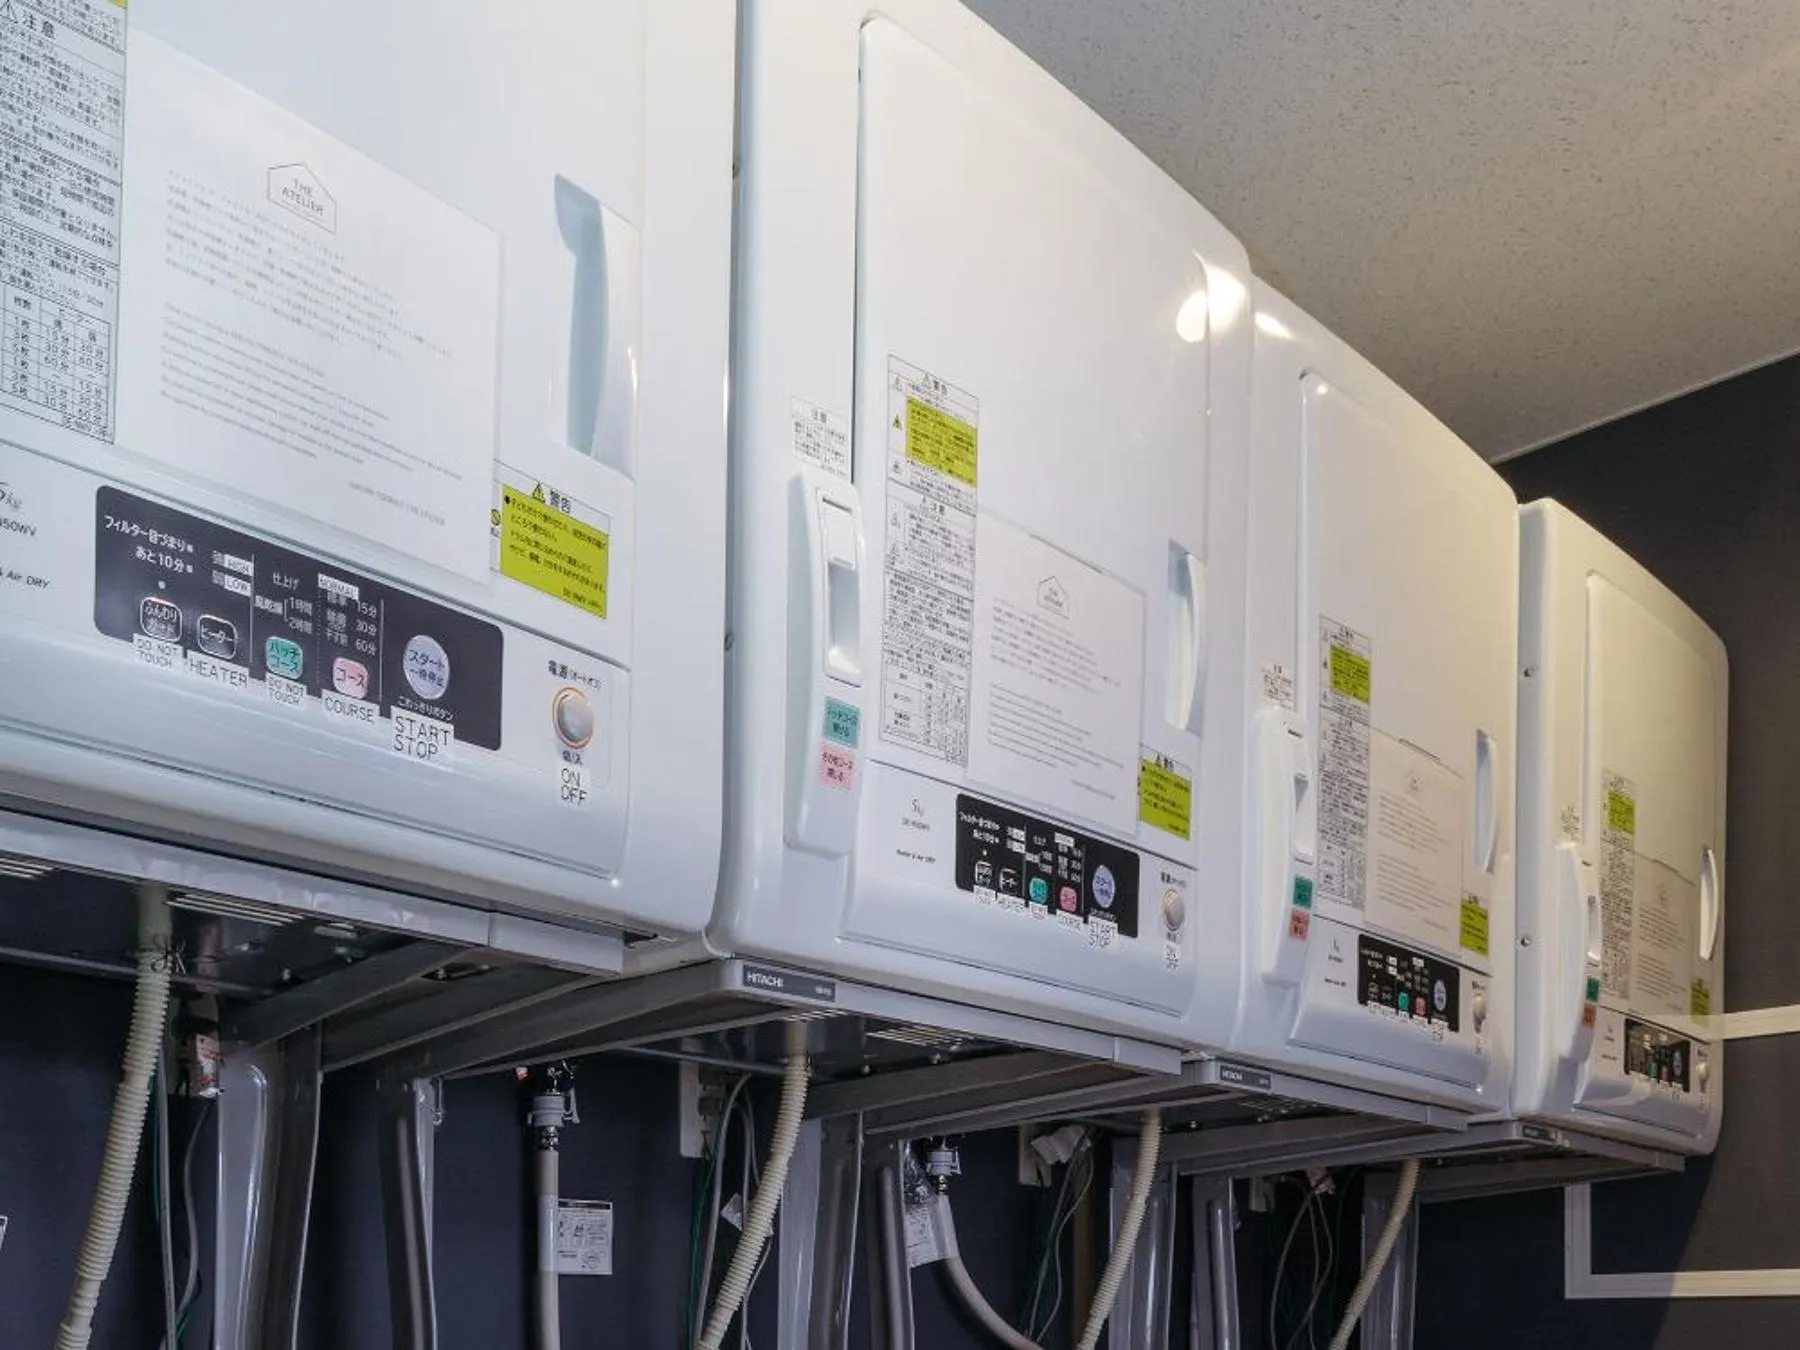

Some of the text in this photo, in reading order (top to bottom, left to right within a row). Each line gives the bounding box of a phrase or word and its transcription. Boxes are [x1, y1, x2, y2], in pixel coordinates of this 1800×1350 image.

[135, 545, 185, 574] あと10分
[26, 575, 50, 589] DRY
[356, 599, 378, 619] 15分
[355, 618, 378, 637] 30分
[136, 637, 179, 658] DO NOT
[355, 637, 377, 657] 60分
[138, 649, 175, 669] TOUCH
[408, 649, 446, 670] スタート
[189, 657, 249, 689] HEATER
[335, 667, 366, 689] コース
[268, 676, 306, 698] DO NOT
[270, 690, 301, 706] TOUCH
[323, 696, 375, 724] COURSE
[394, 715, 450, 747] START
[393, 732, 439, 761] STOP
[560, 768, 581, 788] ON
[560, 784, 588, 805] OFF
[747, 970, 784, 988] HITACHI
